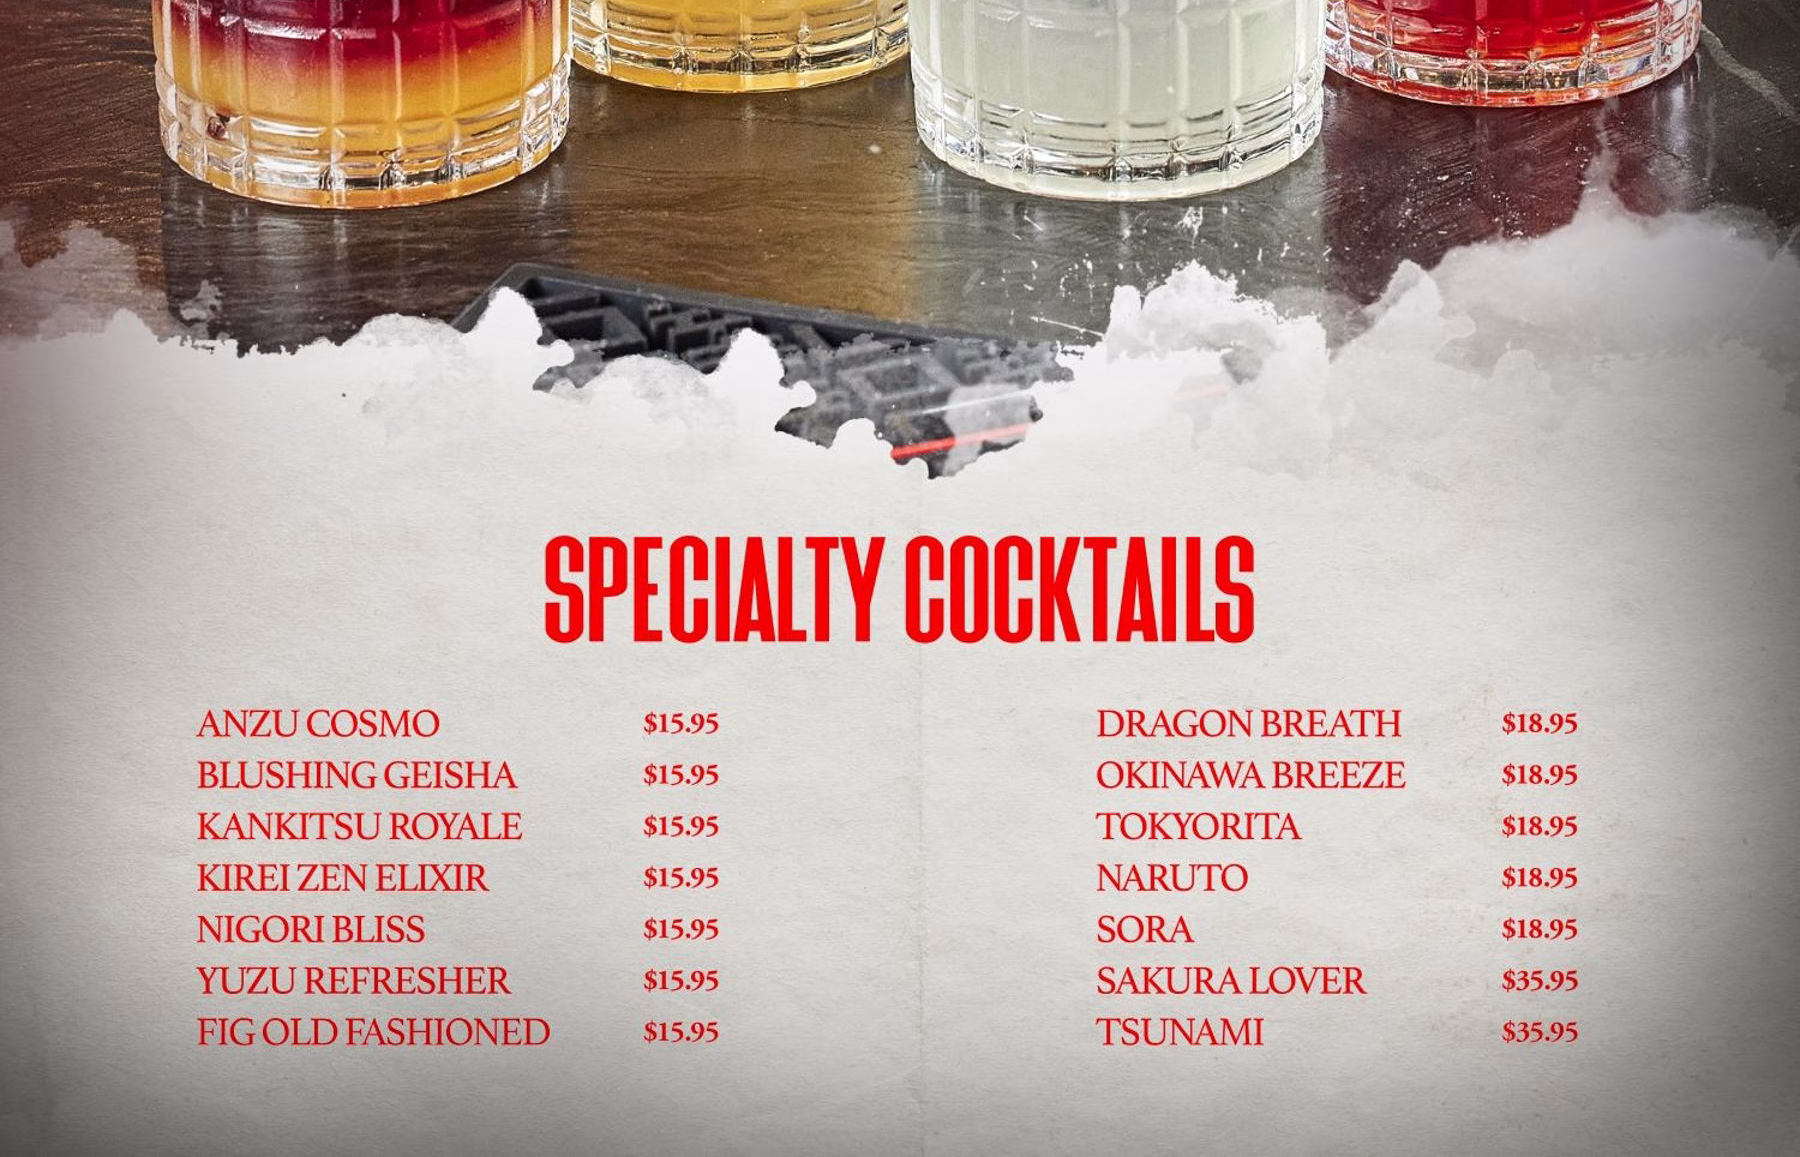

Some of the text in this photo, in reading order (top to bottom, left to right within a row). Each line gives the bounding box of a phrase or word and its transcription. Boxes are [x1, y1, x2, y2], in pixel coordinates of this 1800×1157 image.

[544, 535, 1254, 644] SPECIALTY COCKTAILS
[198, 709, 440, 739] ANZU COSMO
[644, 713, 720, 735] $15.95
[1098, 709, 1402, 738] DRAGON BREATH
[1502, 713, 1578, 733] $18.95
[198, 759, 516, 791] BLUSHING GEISHA
[644, 763, 719, 787] $15.95
[1096, 761, 1406, 789] OKINAWA BREEZE
[1502, 763, 1578, 787] $18.95
[196, 811, 522, 841] KANKITSU ROYALE
[644, 815, 718, 837] $15.95
[1096, 812, 1300, 841] TOKYORITA
[1504, 815, 1578, 837] $18.95
[198, 862, 488, 893] KIREI ZEN ELIXIR
[644, 865, 720, 889] $15.95
[1098, 863, 1248, 891] NARUTO
[1502, 867, 1578, 889] $18.95
[198, 915, 426, 943] NIGORI BLISS
[644, 919, 718, 939] $15.95
[1098, 915, 1194, 943] SORA
[1502, 917, 1578, 939] $18.95
[198, 965, 510, 995] YUZU REFRESHER
[644, 969, 720, 991] $15.95
[1098, 965, 1366, 995] SAKURA LOVER
[1502, 969, 1578, 991] $35.95
[198, 1017, 550, 1047] FIG OLD FASHIONED
[644, 1021, 720, 1043] $15.95
[1096, 1017, 1262, 1047] TSUNAMI
[1504, 1021, 1578, 1043] $35.95
